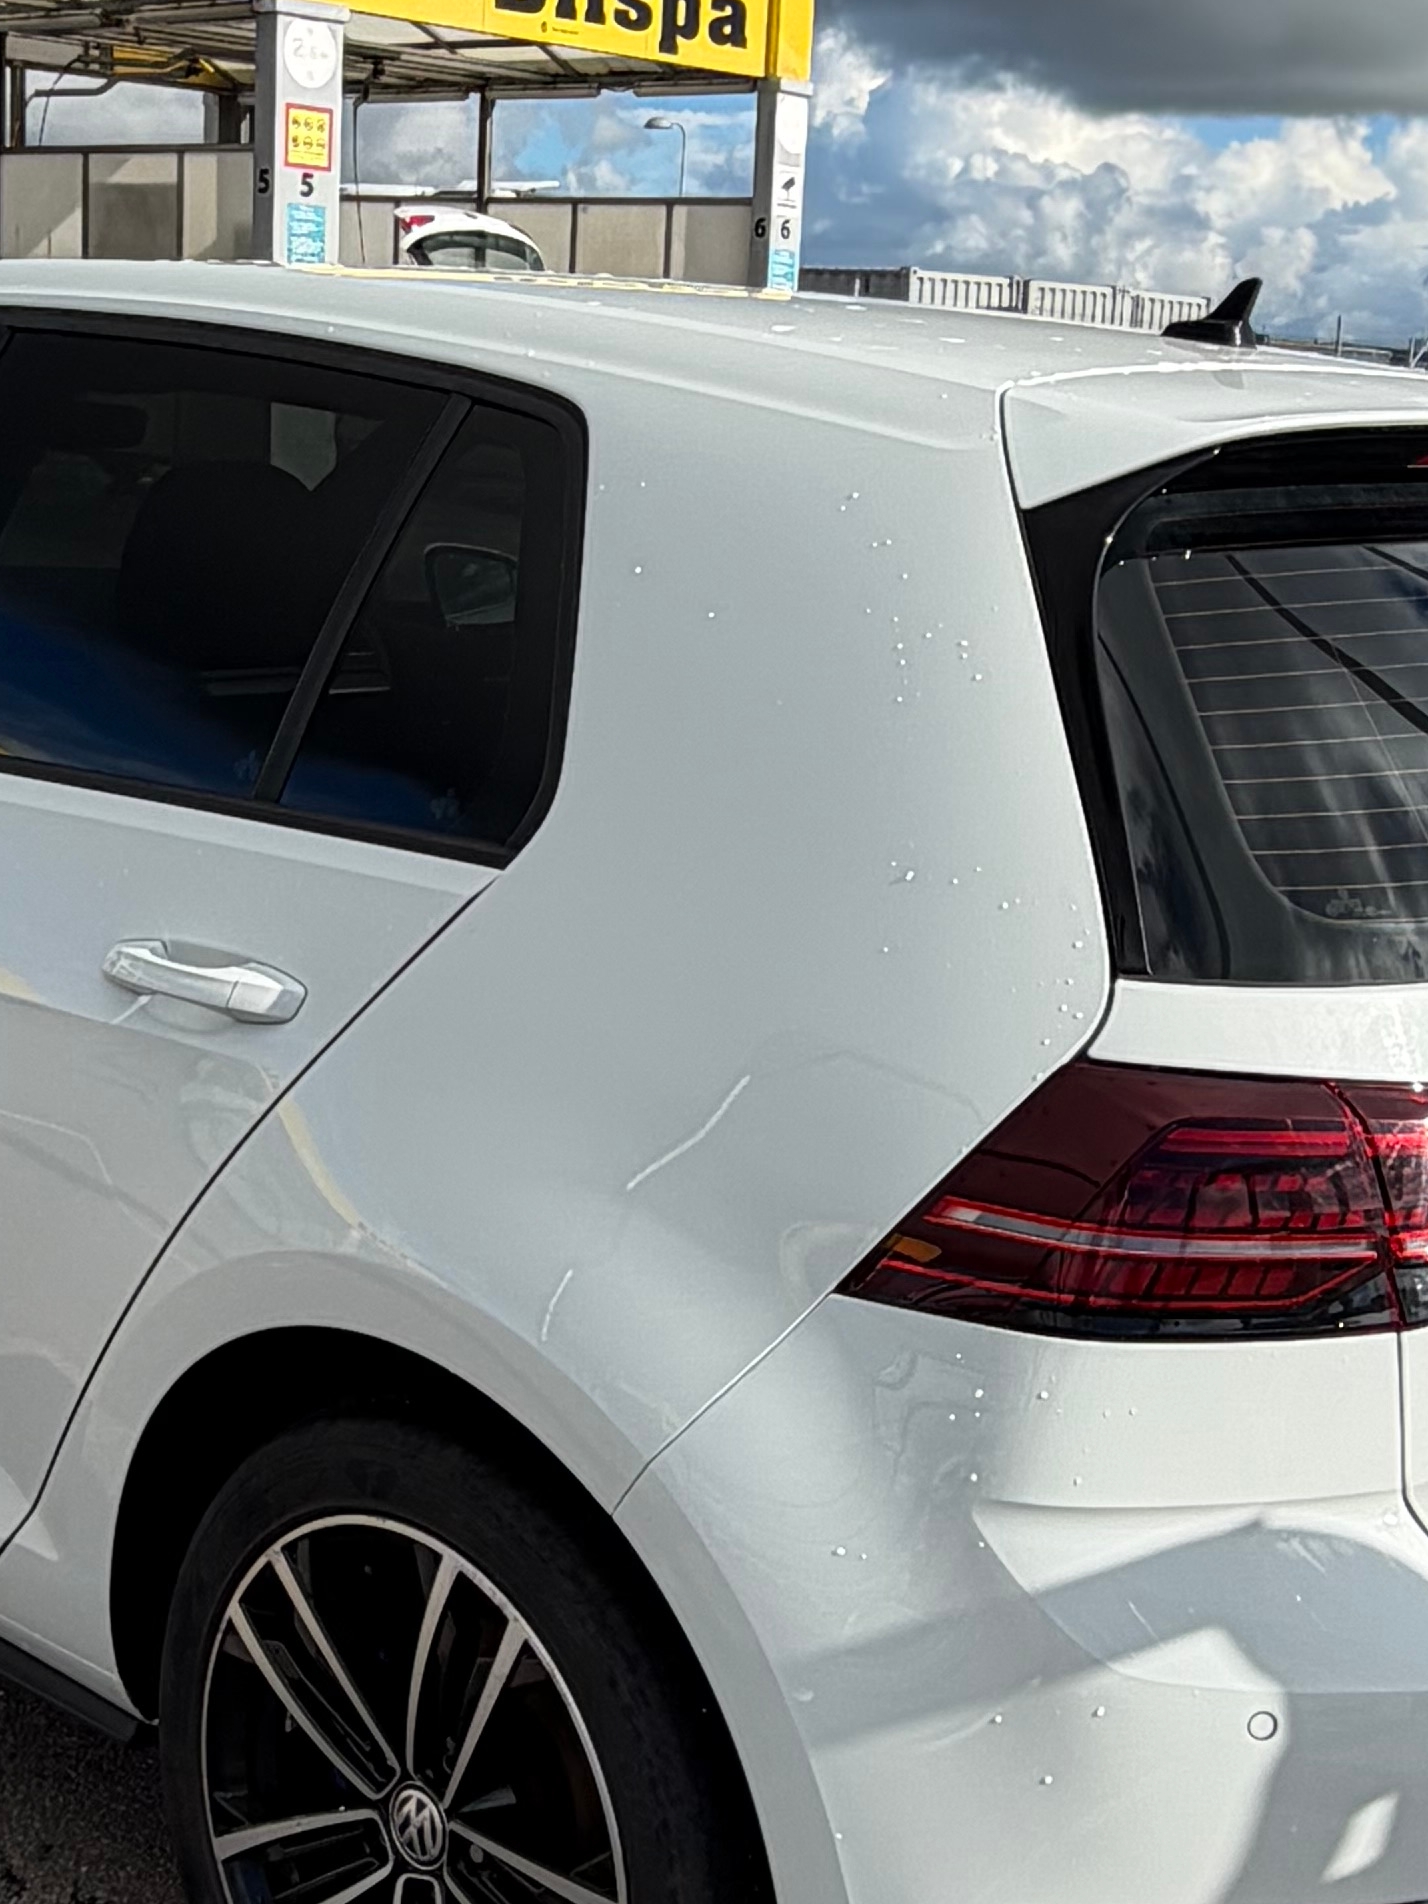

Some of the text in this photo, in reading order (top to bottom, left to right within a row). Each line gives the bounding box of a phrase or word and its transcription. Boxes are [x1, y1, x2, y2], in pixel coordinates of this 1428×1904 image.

[257, 168, 271, 195] 5
[300, 172, 315, 198] 5
[754, 217, 767, 239] 6
[780, 218, 792, 240] 6
